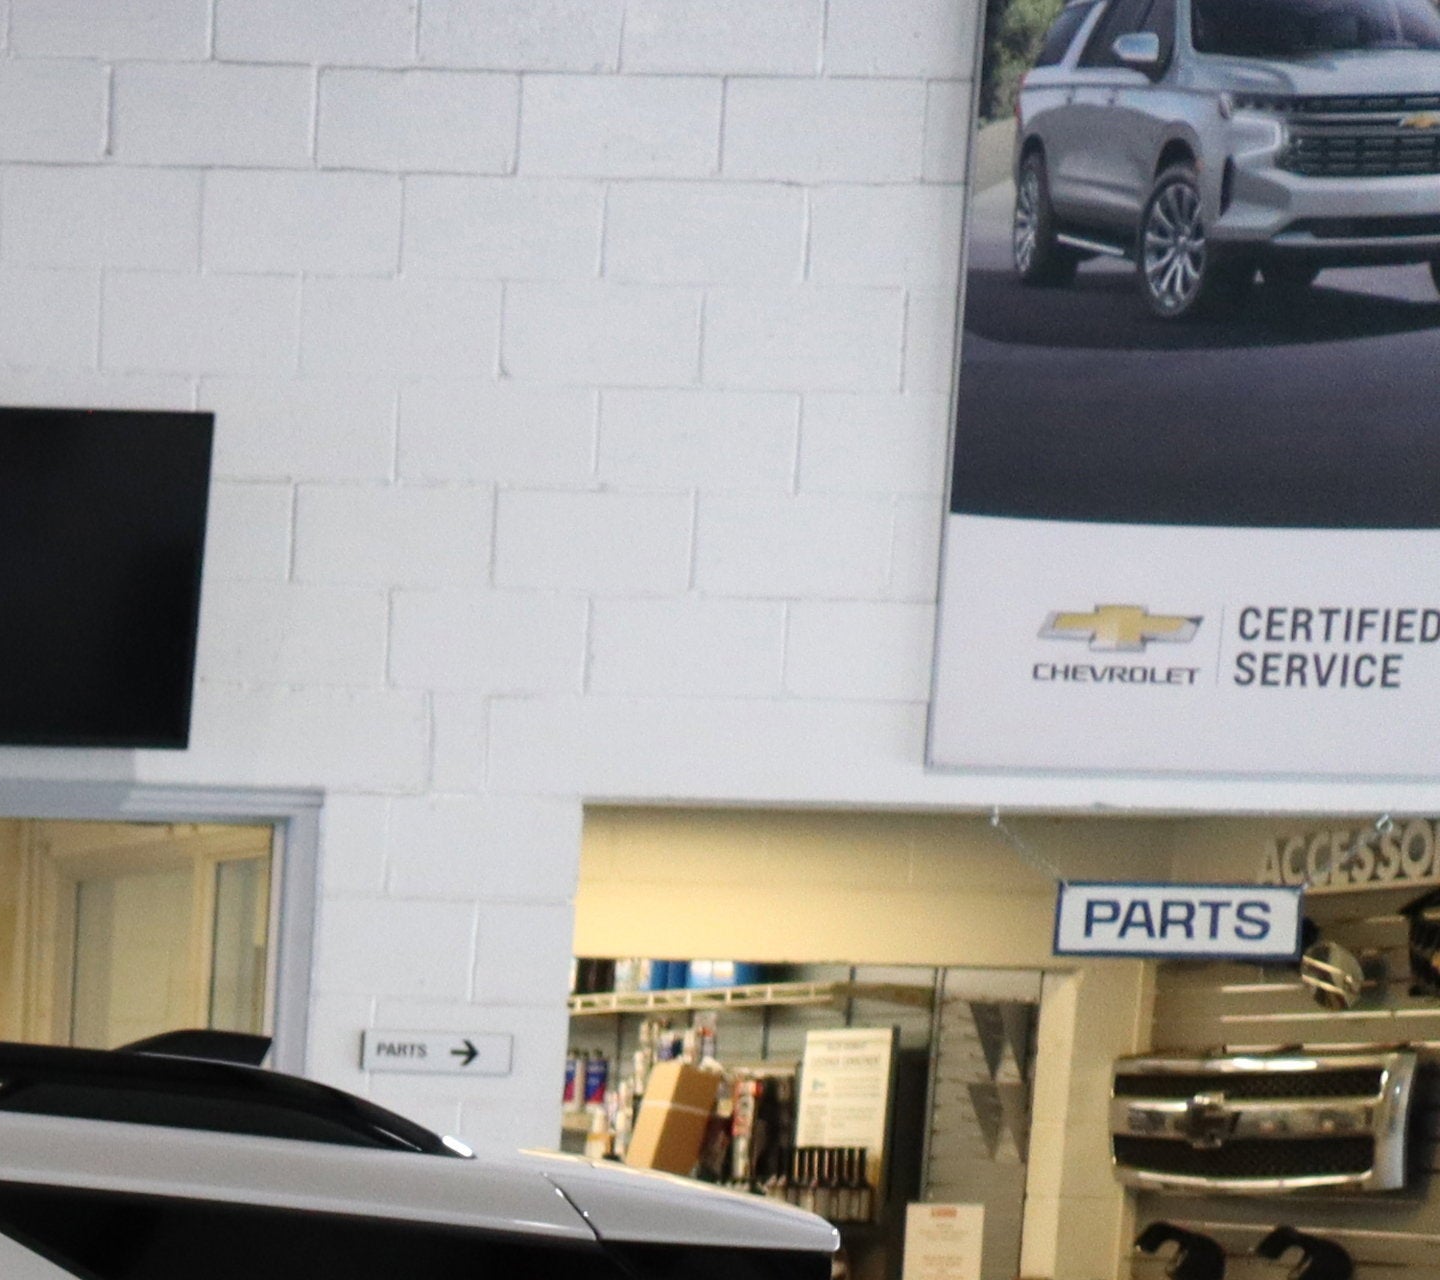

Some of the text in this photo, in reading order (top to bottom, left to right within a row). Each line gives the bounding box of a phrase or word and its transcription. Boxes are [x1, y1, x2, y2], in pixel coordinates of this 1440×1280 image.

[1237, 606, 1440, 643] CERTIFIED
[1031, 662, 1201, 686] CHEVROLET
[1233, 651, 1404, 689] SERVICE
[1083, 898, 1273, 941] PARTS
[375, 1041, 429, 1059] PARTS
